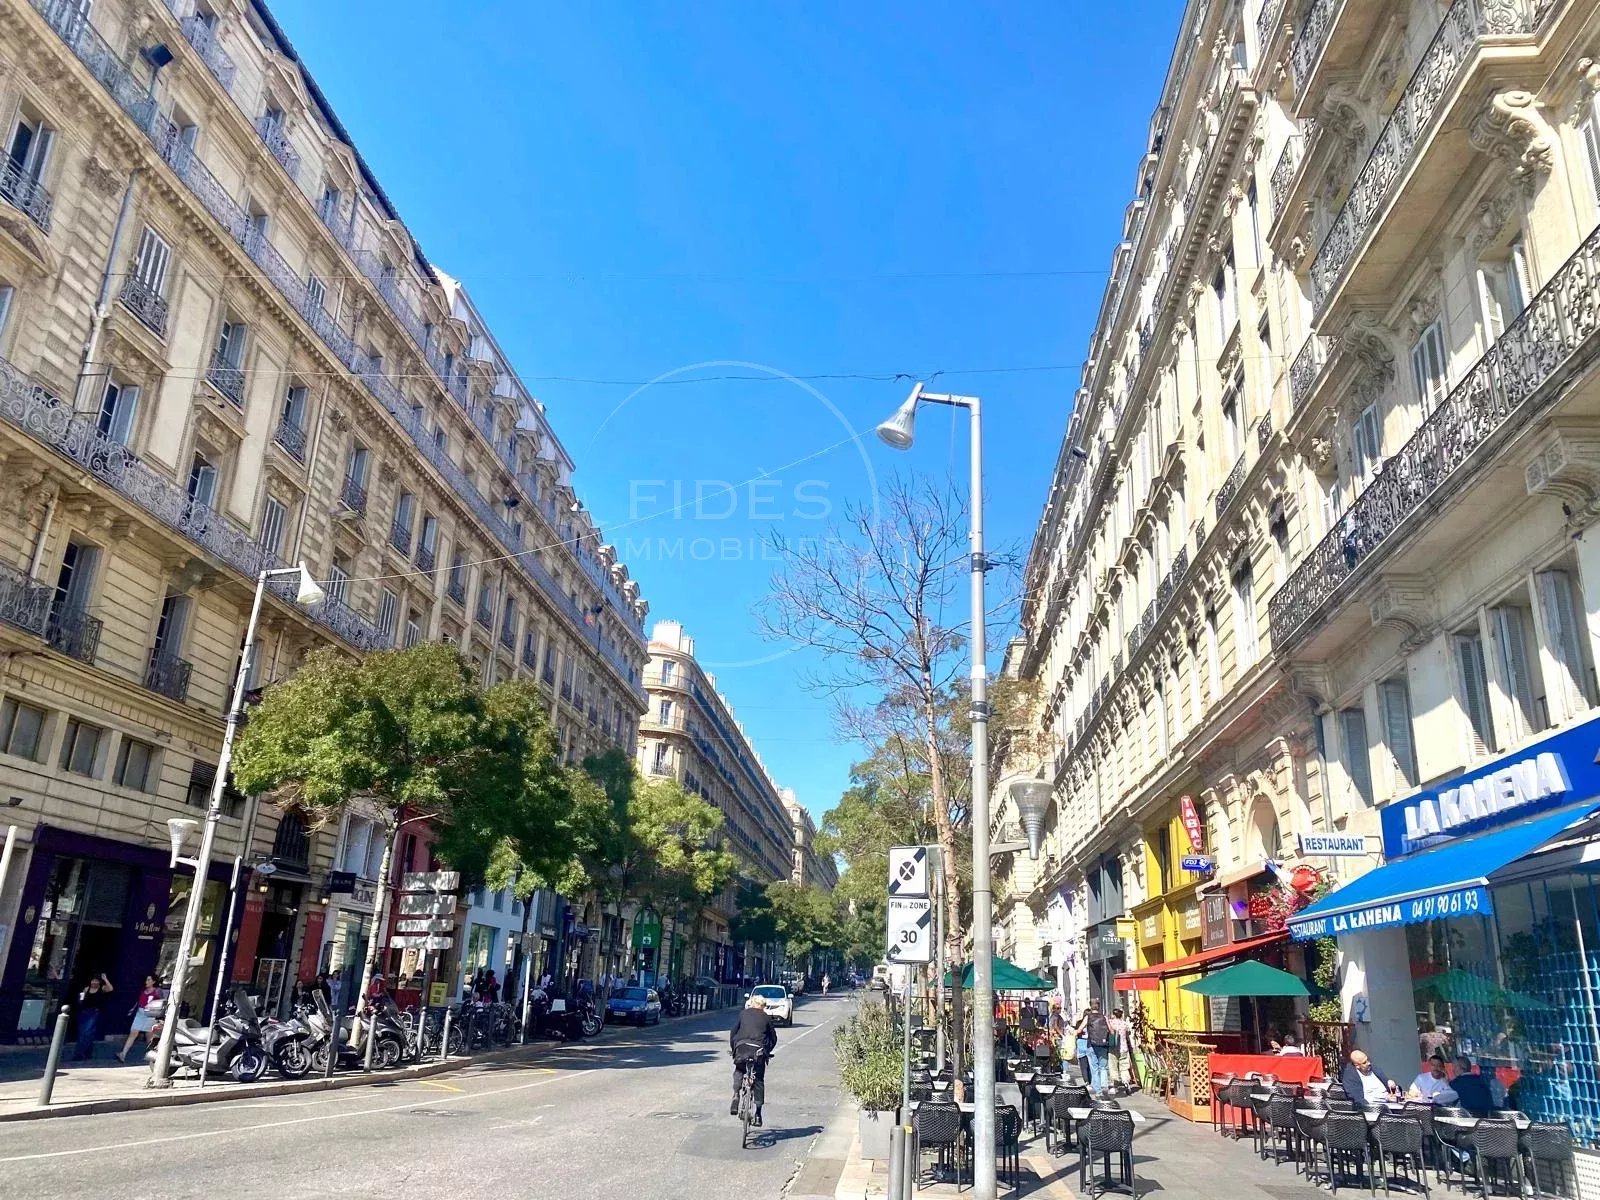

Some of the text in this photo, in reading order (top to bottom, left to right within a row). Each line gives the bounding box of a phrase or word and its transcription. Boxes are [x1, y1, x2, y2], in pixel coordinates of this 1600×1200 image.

[1404, 752, 1570, 841] LA KAHENA
[1183, 799, 1202, 849] TABAC
[1305, 837, 1364, 851] RESTAURANT
[890, 901, 902, 909] FIN
[909, 901, 928, 909] ZONE
[1332, 915, 1348, 932] LA
[1412, 900, 1423, 918] 04
[1425, 898, 1435, 916] 91
[1437, 894, 1449, 914] 90
[1450, 892, 1462, 912] 61
[1465, 890, 1478, 911] 93
[900, 930, 917, 944] 30
